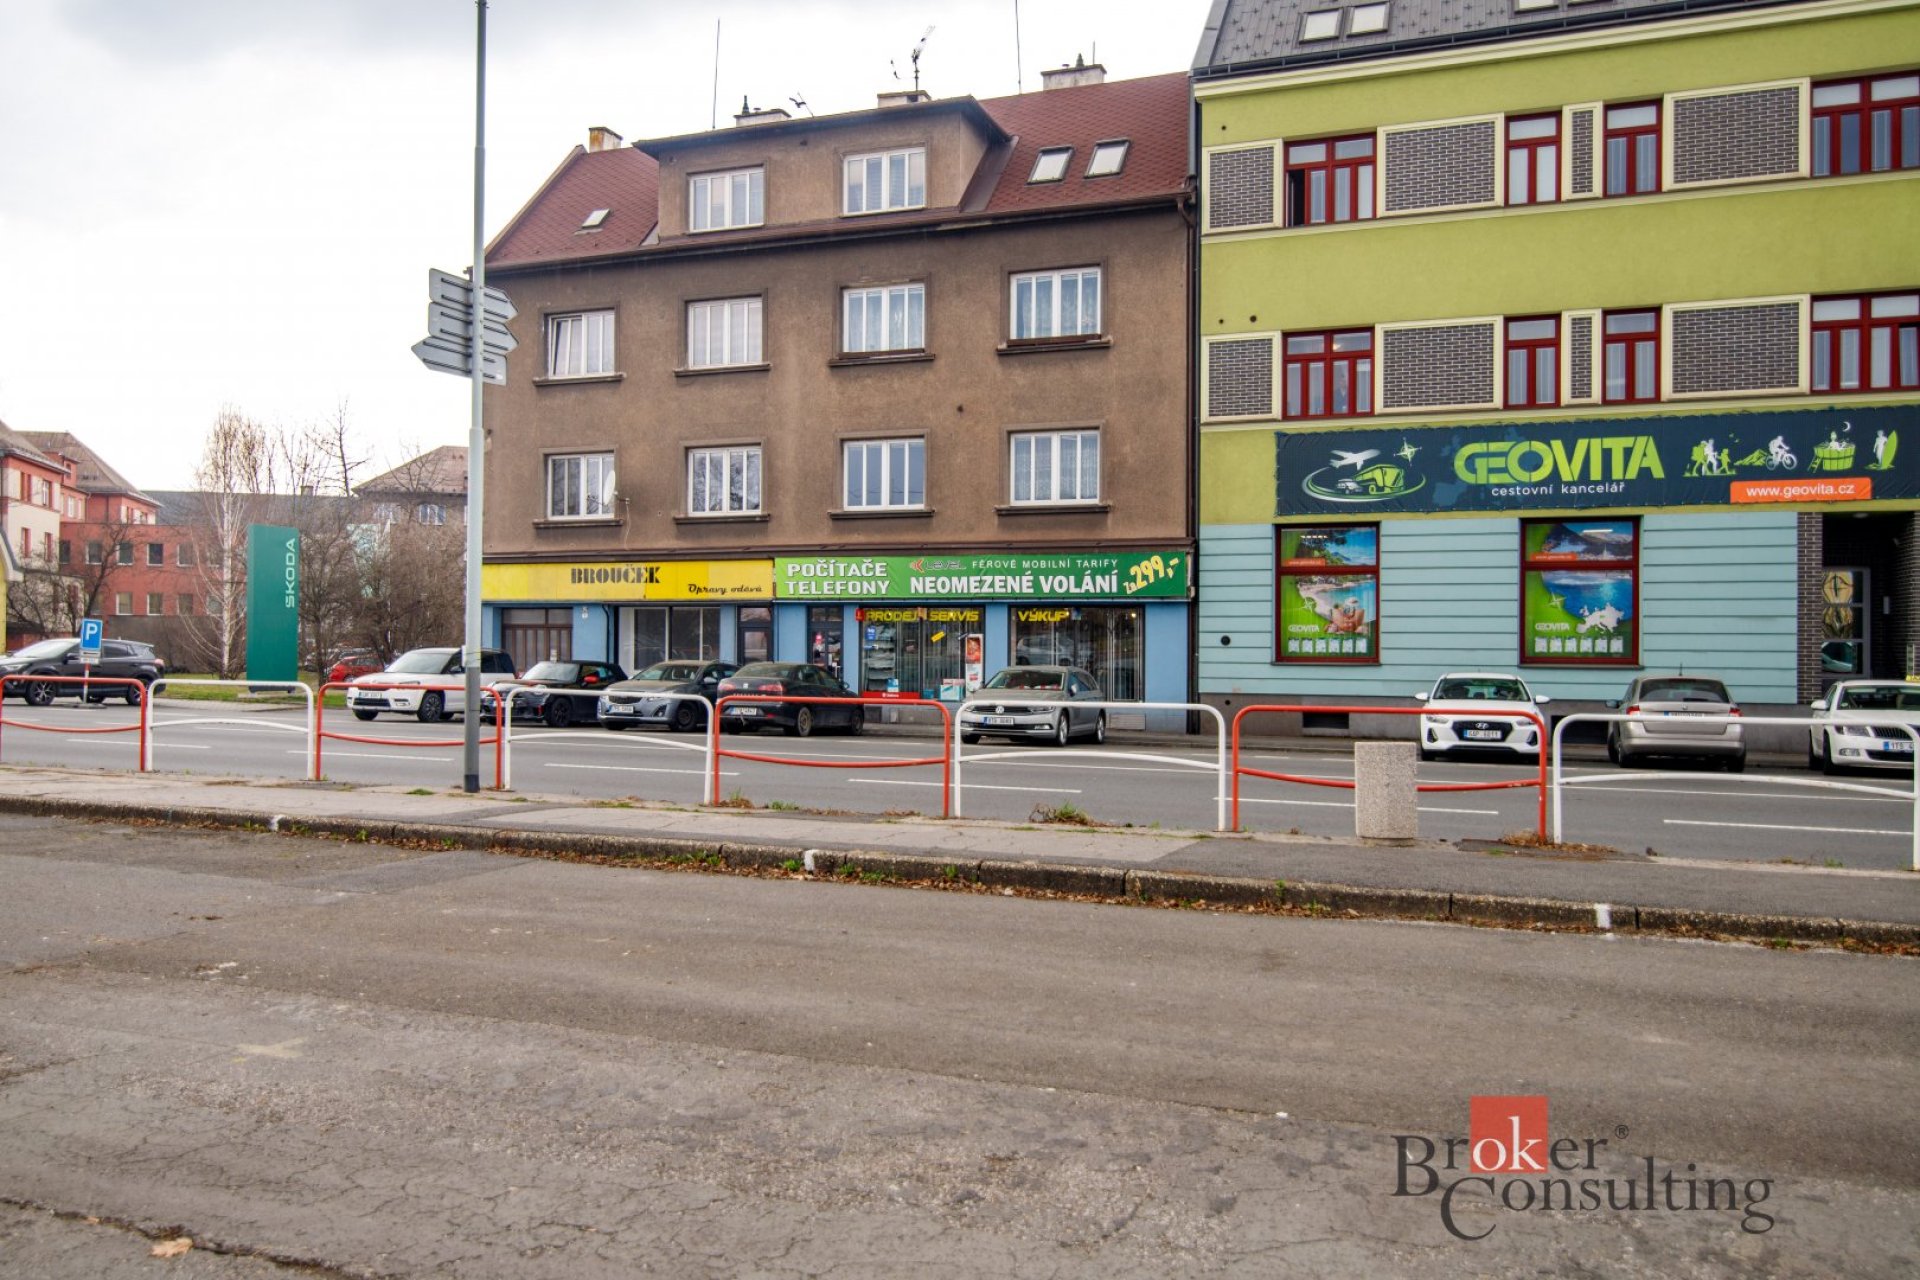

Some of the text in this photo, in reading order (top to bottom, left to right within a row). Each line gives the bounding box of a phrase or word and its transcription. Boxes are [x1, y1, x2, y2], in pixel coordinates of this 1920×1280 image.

[1453, 436, 1665, 485] GEOVITA
[1491, 481, 1626, 496] cestovní kancelář
[1746, 482, 1856, 499] www.geovita.cz
[787, 559, 888, 577] POČÍTAČE
[972, 559, 1017, 569] FÉROVÉ
[1022, 558, 1071, 569] MOBILNÍ
[1076, 558, 1118, 568] TARIFY
[571, 564, 661, 584] BROUČEK
[910, 570, 1119, 594] NEOMEZENÉ VOLÁNÍ
[687, 583, 727, 595] Opravy
[785, 580, 890, 595] TELEFONY
[929, 610, 979, 621] SERVIS
[1018, 608, 1069, 622] VÝKUP
[86, 622, 98, 640] P
